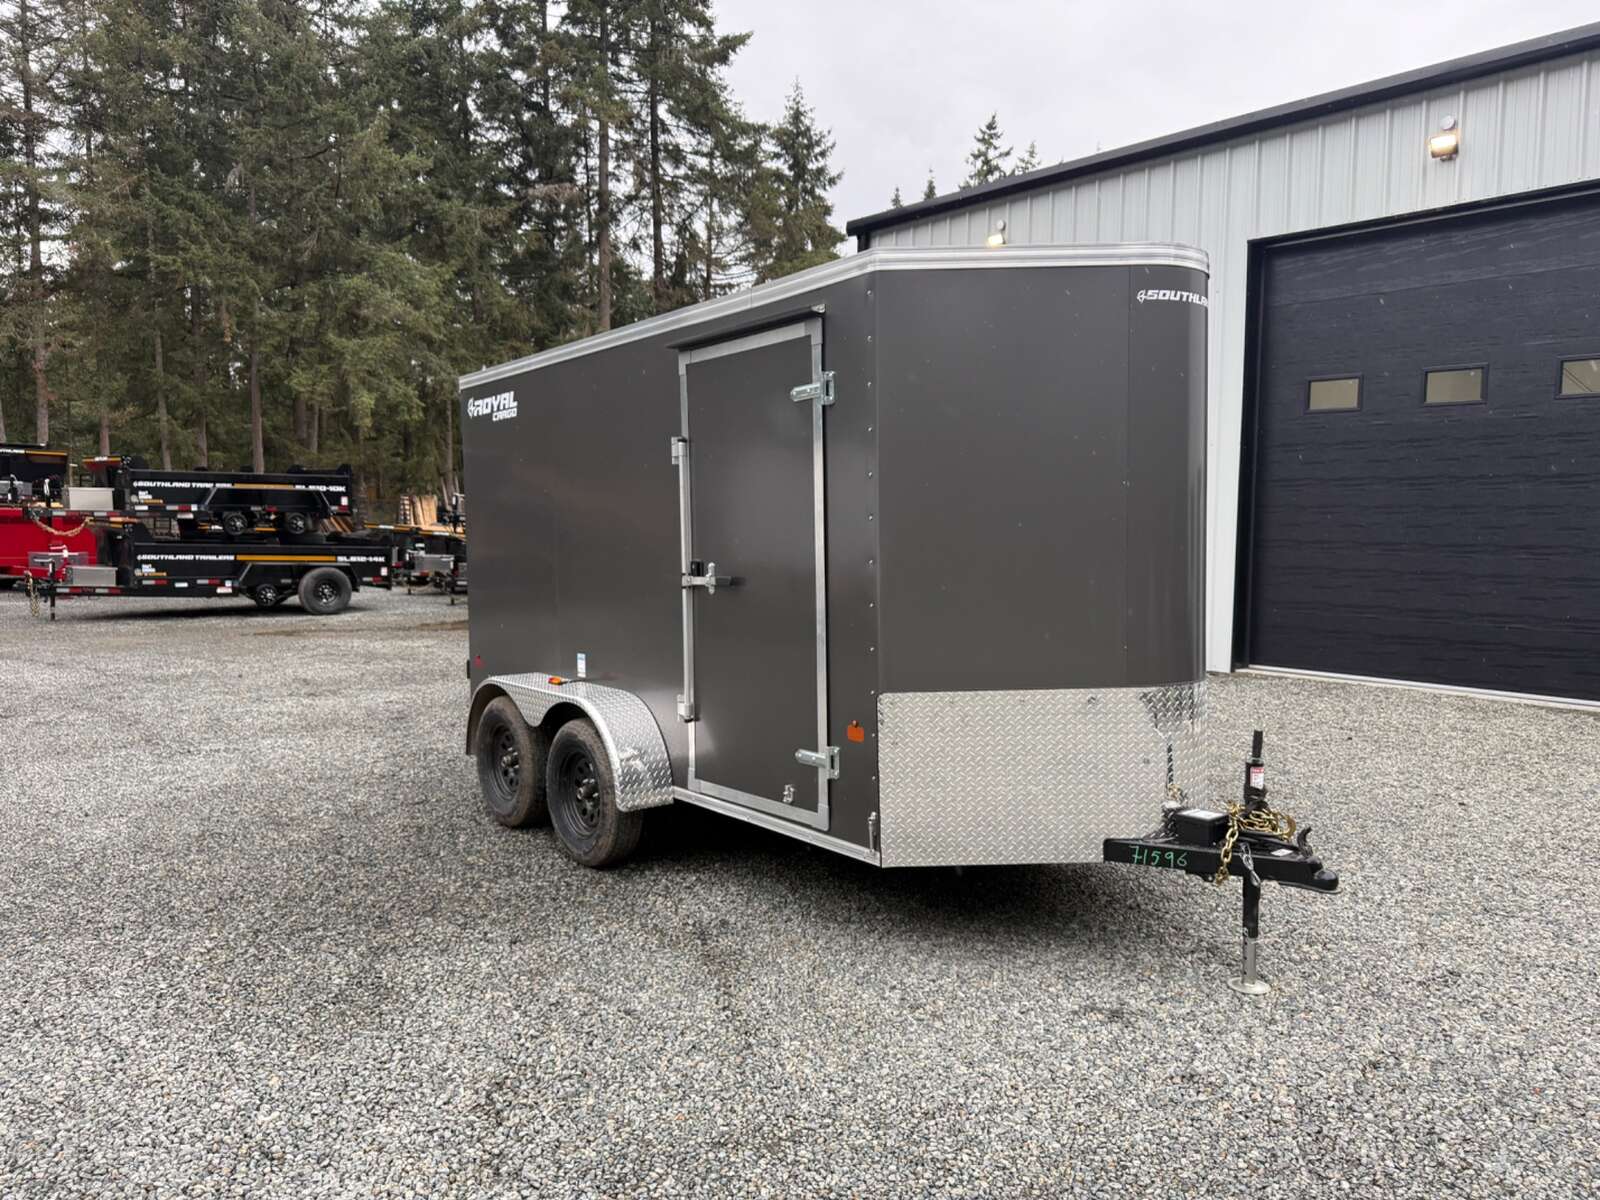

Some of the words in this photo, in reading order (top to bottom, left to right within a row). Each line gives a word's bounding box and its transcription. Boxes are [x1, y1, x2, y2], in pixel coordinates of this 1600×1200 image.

[1146, 289, 1208, 307] SOUTHLA
[473, 391, 518, 416] ROYAL
[1129, 845, 1188, 868] 71596
